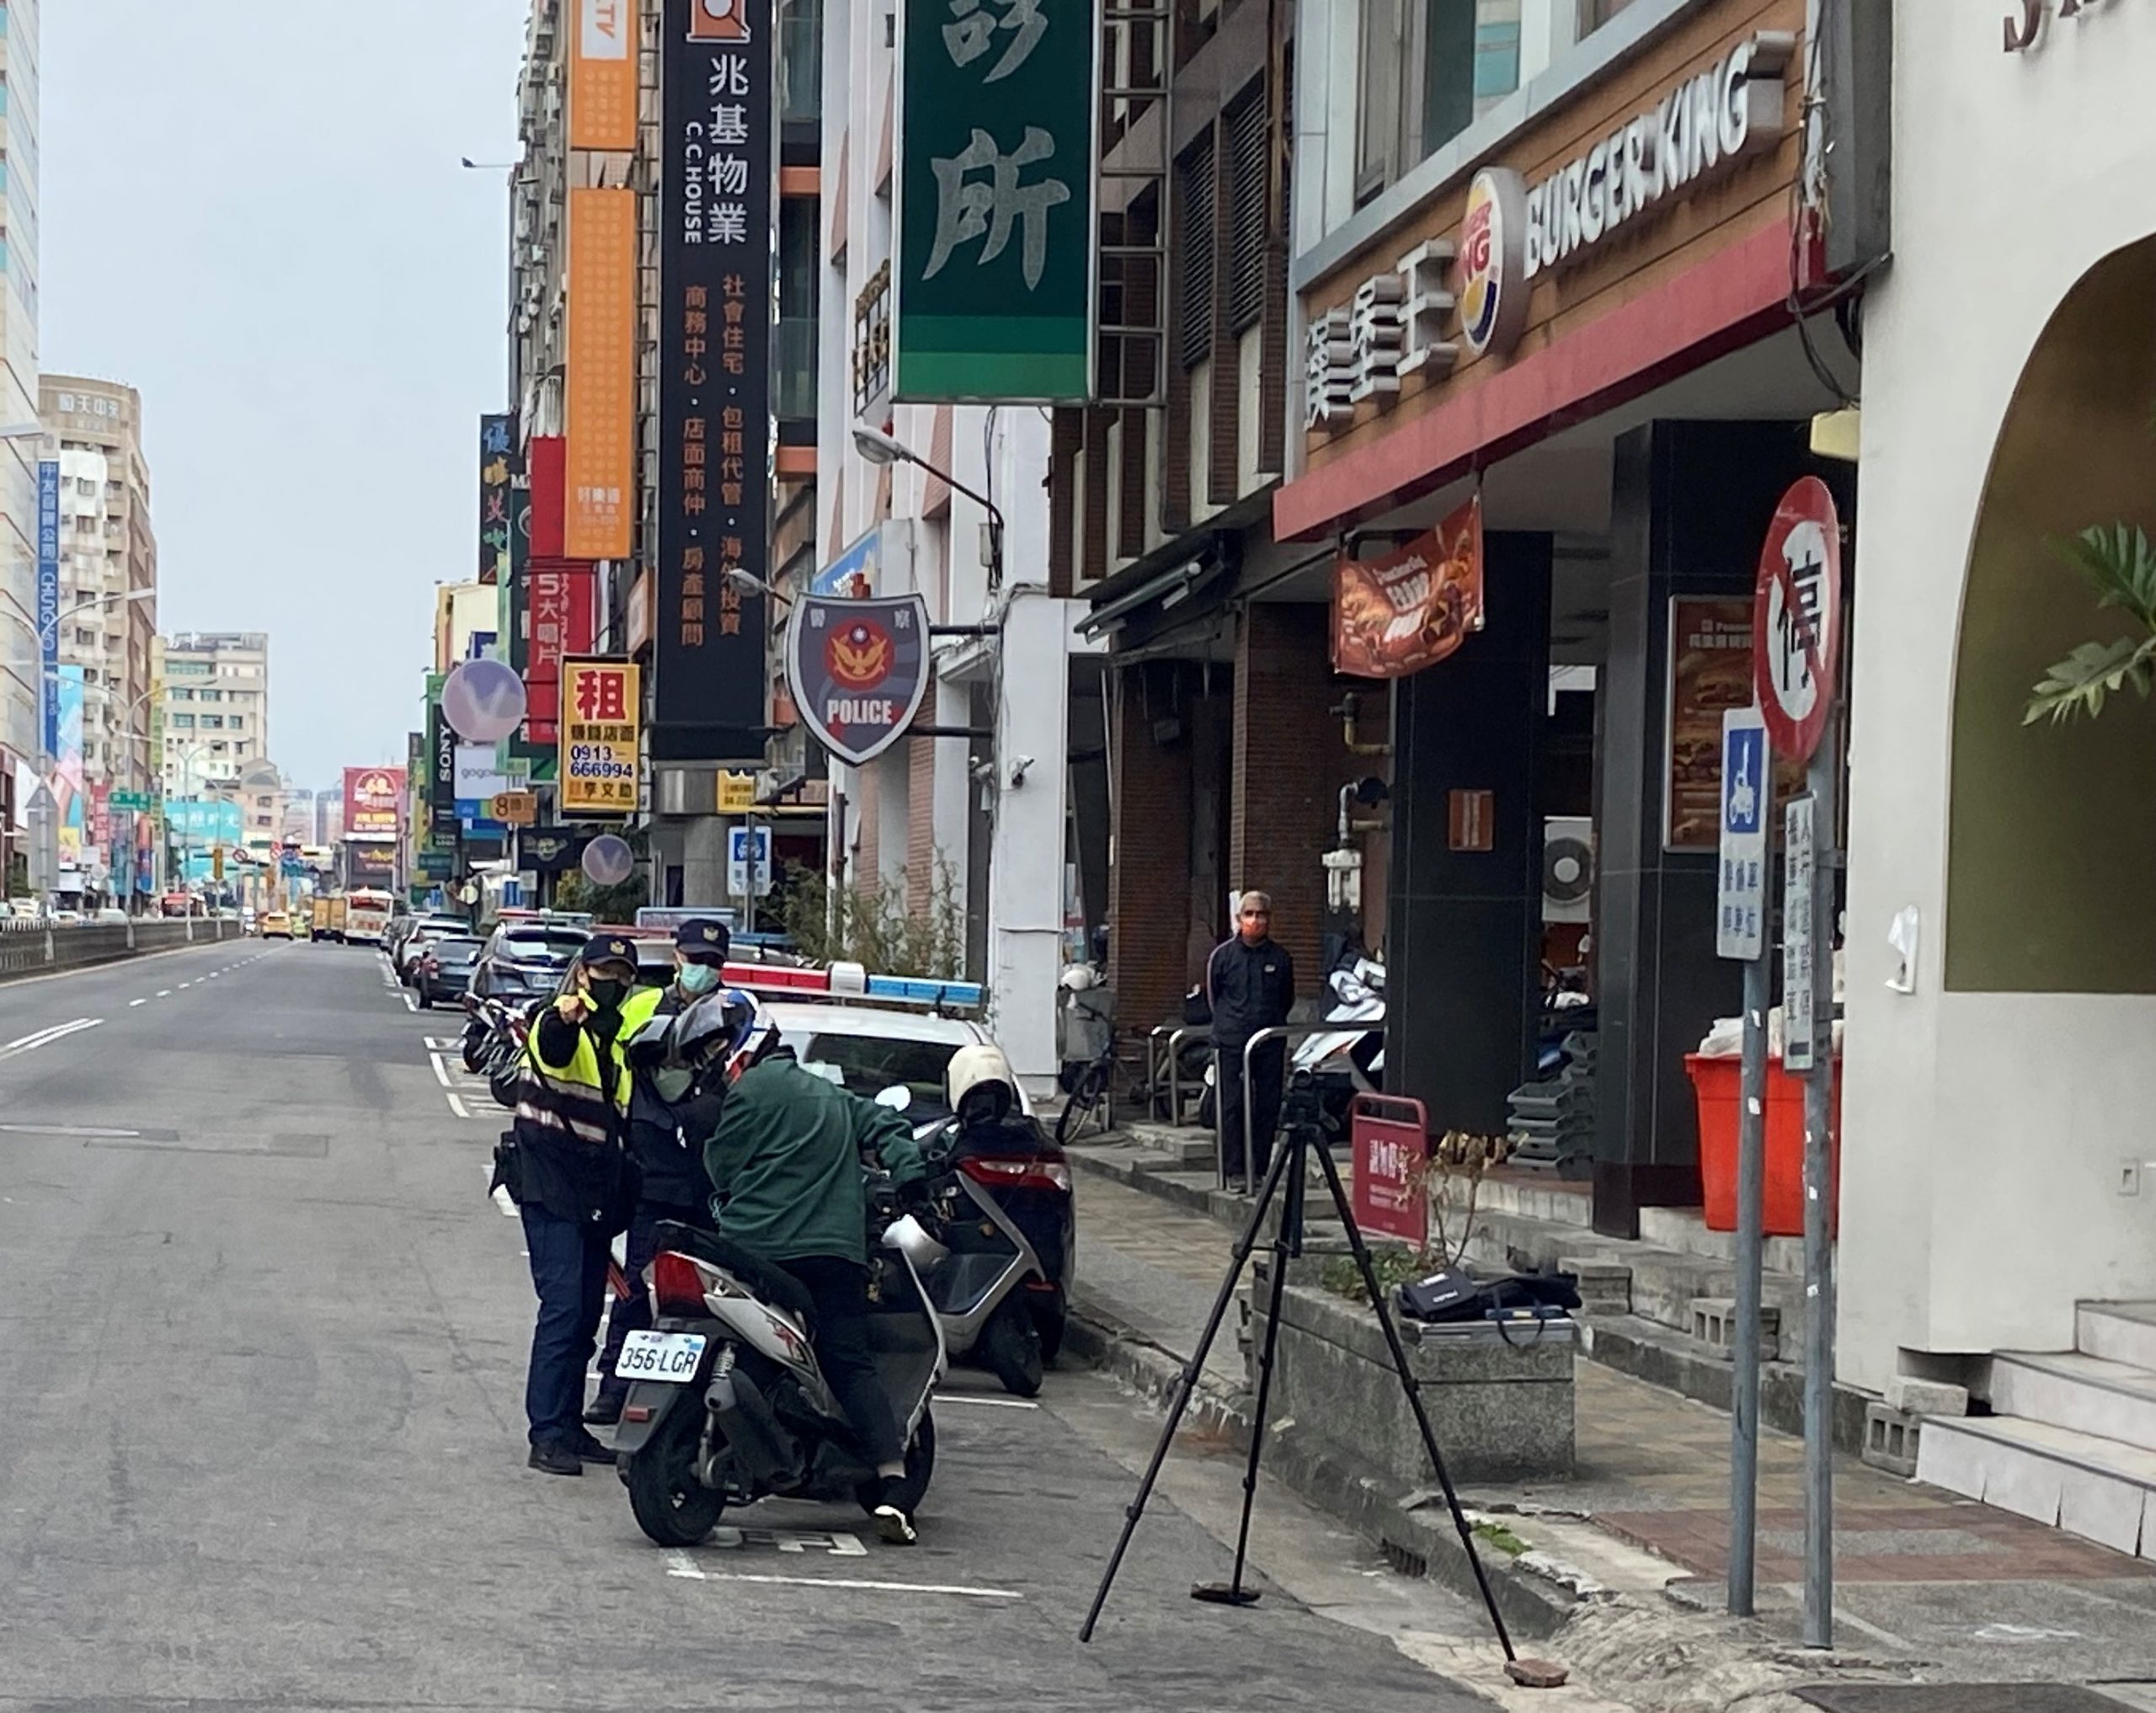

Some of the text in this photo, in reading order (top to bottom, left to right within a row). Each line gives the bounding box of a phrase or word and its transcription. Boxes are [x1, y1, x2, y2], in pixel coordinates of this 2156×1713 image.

[595, 0, 616, 40] TV
[707, 54, 750, 244] 兆基物業
[1524, 116, 1646, 280] BURGER
[1654, 40, 1752, 200] KING
[1304, 239, 1433, 432] 漢堡王
[576, 670, 627, 722] 租
[826, 698, 894, 725] POLICE
[439, 723, 452, 783] SONY
[570, 761, 633, 779] 666994
